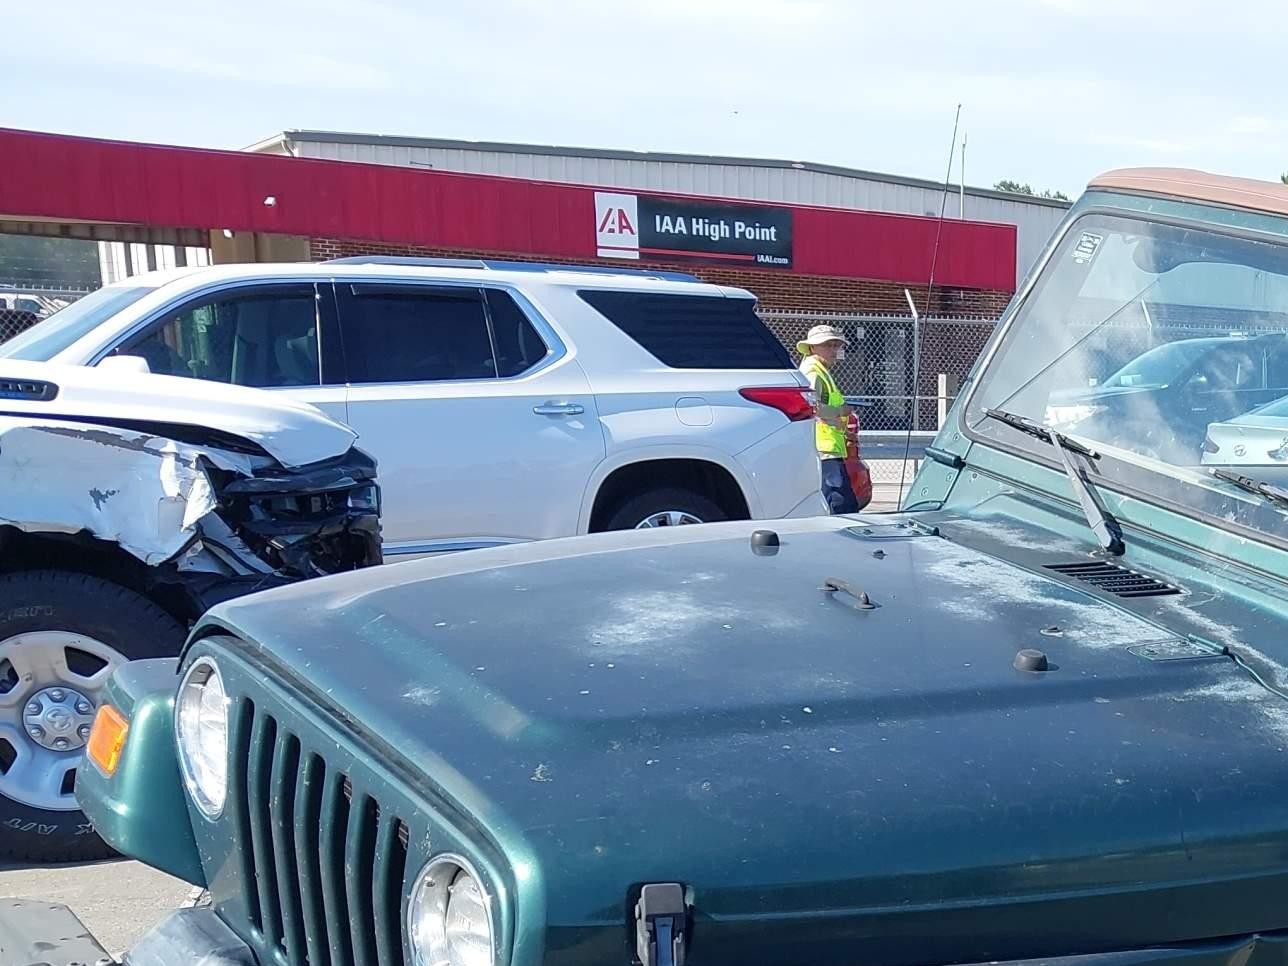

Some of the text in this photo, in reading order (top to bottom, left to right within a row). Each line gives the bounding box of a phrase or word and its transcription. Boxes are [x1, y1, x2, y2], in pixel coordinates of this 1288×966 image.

[655, 214, 777, 242] IAA High Point
